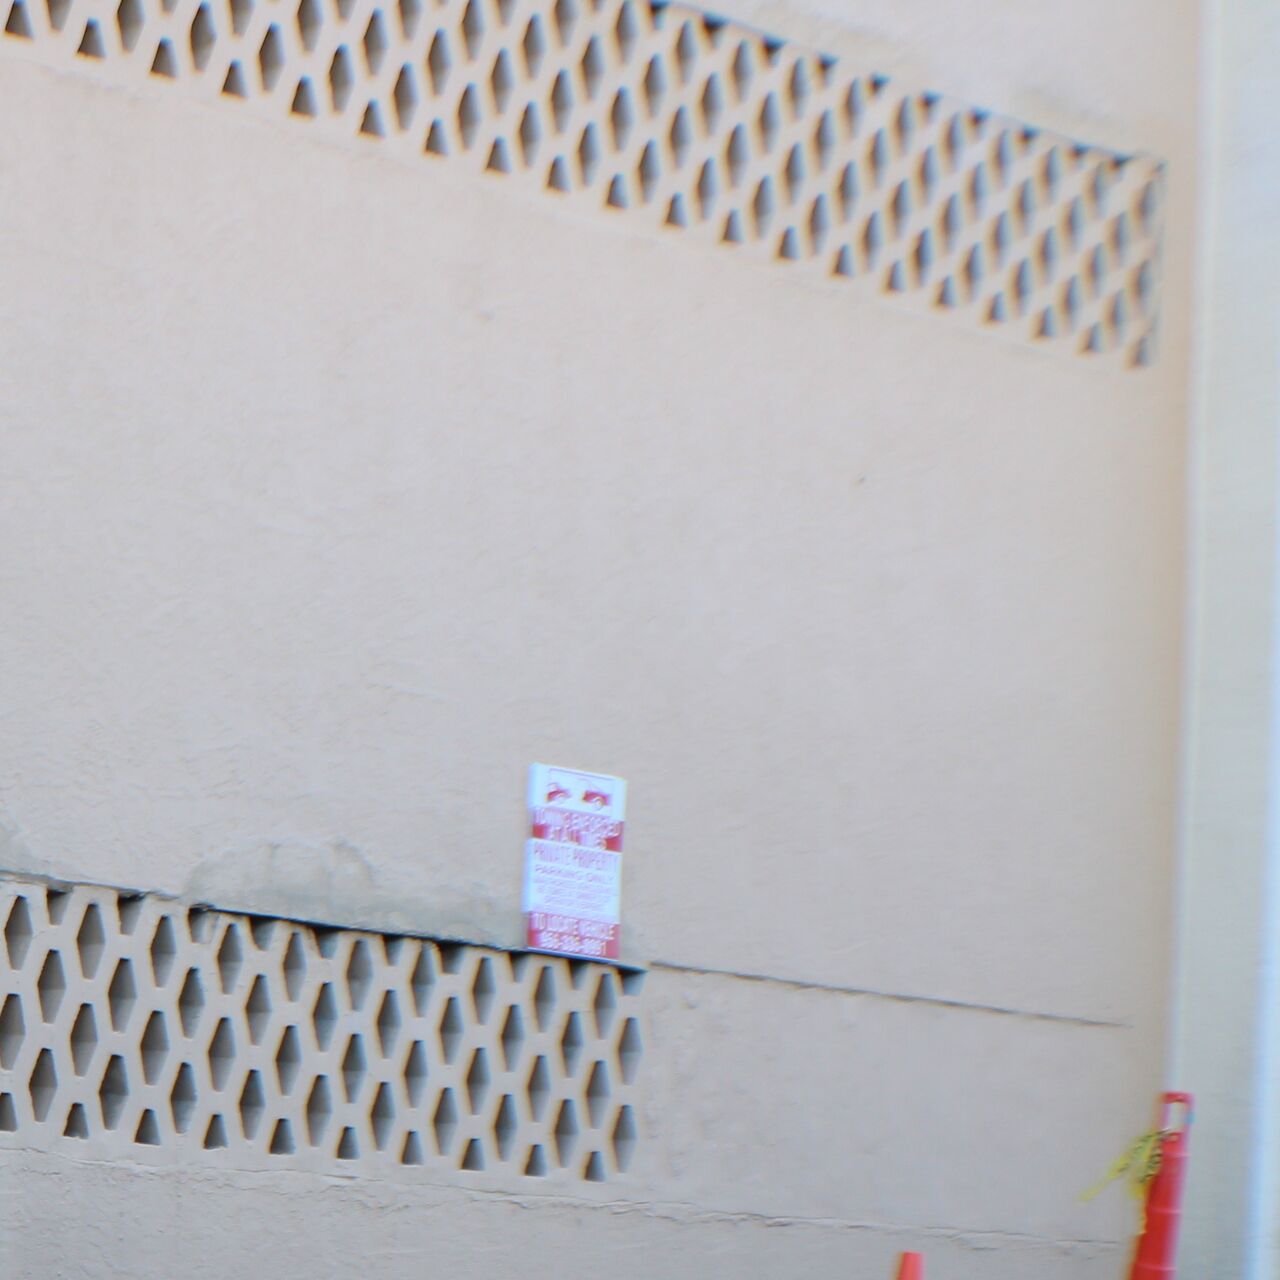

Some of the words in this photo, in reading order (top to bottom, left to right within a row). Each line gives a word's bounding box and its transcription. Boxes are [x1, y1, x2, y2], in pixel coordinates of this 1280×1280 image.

[533, 840, 572, 866] PRIVATE
[572, 847, 618, 874] PROPERTY
[534, 864, 584, 880] PARKING
[586, 871, 615, 885] ONLY
